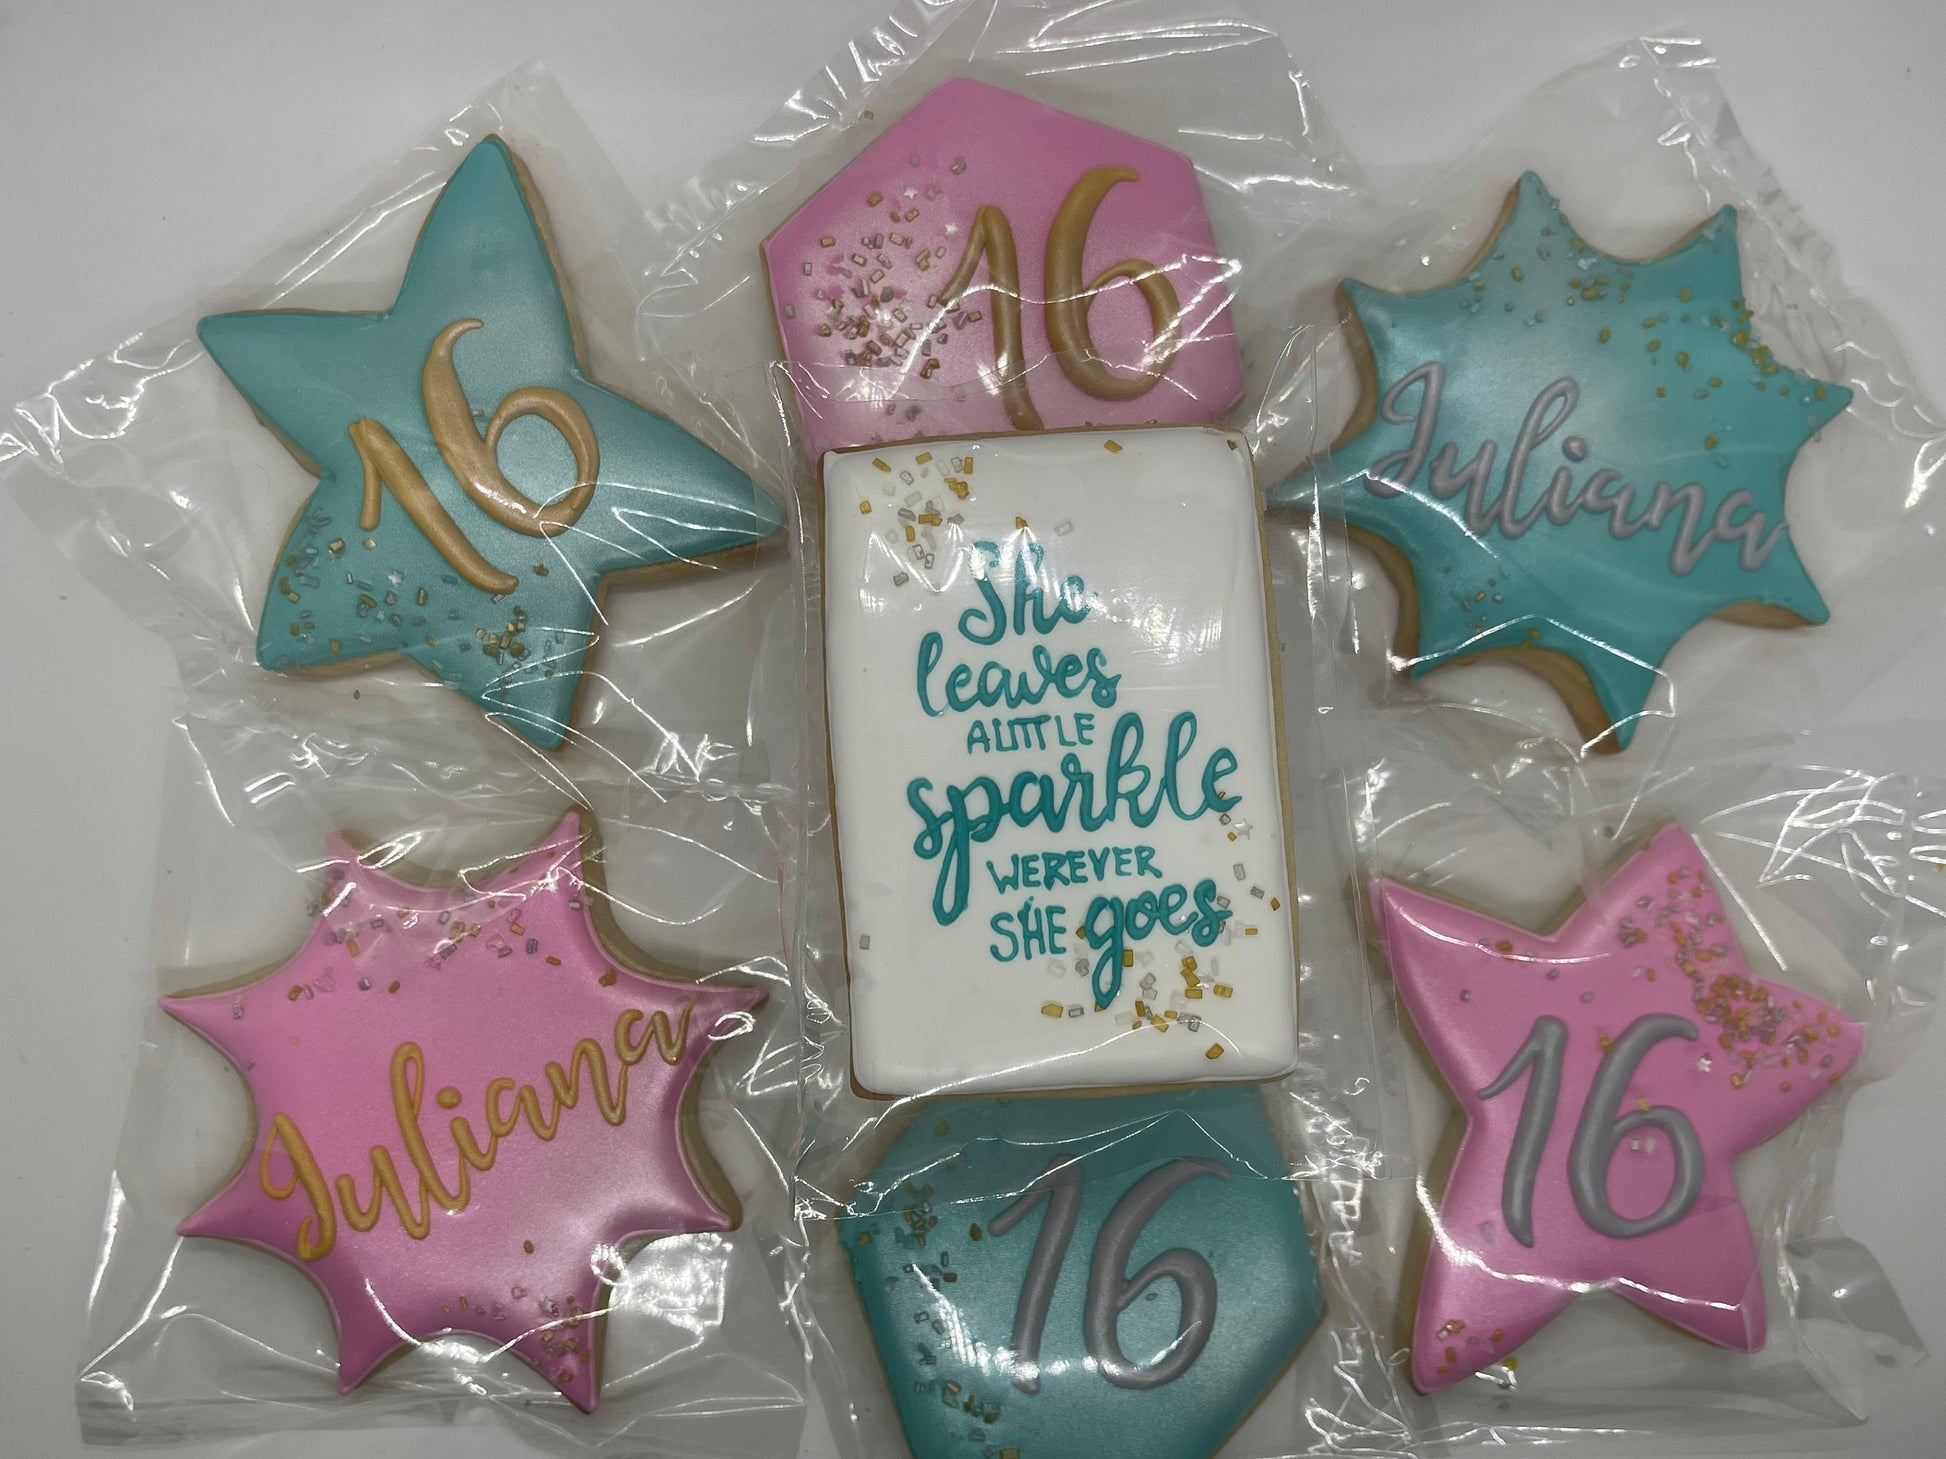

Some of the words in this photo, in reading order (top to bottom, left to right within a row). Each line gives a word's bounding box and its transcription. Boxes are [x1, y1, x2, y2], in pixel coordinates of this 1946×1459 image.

[938, 166, 1182, 431] 16
[348, 318, 599, 594] 16
[1363, 360, 1790, 576] Juliana
[917, 631, 1122, 717] leaves
[958, 540, 1097, 645] She
[906, 711, 1243, 925] sparkle
[967, 720, 991, 754] A
[986, 845, 1163, 894] WEREVER
[990, 896, 1067, 962] SHE
[1084, 879, 1233, 1010] goes
[260, 1001, 697, 1262] Juliana
[1476, 1013, 1701, 1248] 16
[988, 1153, 1231, 1394] 16
